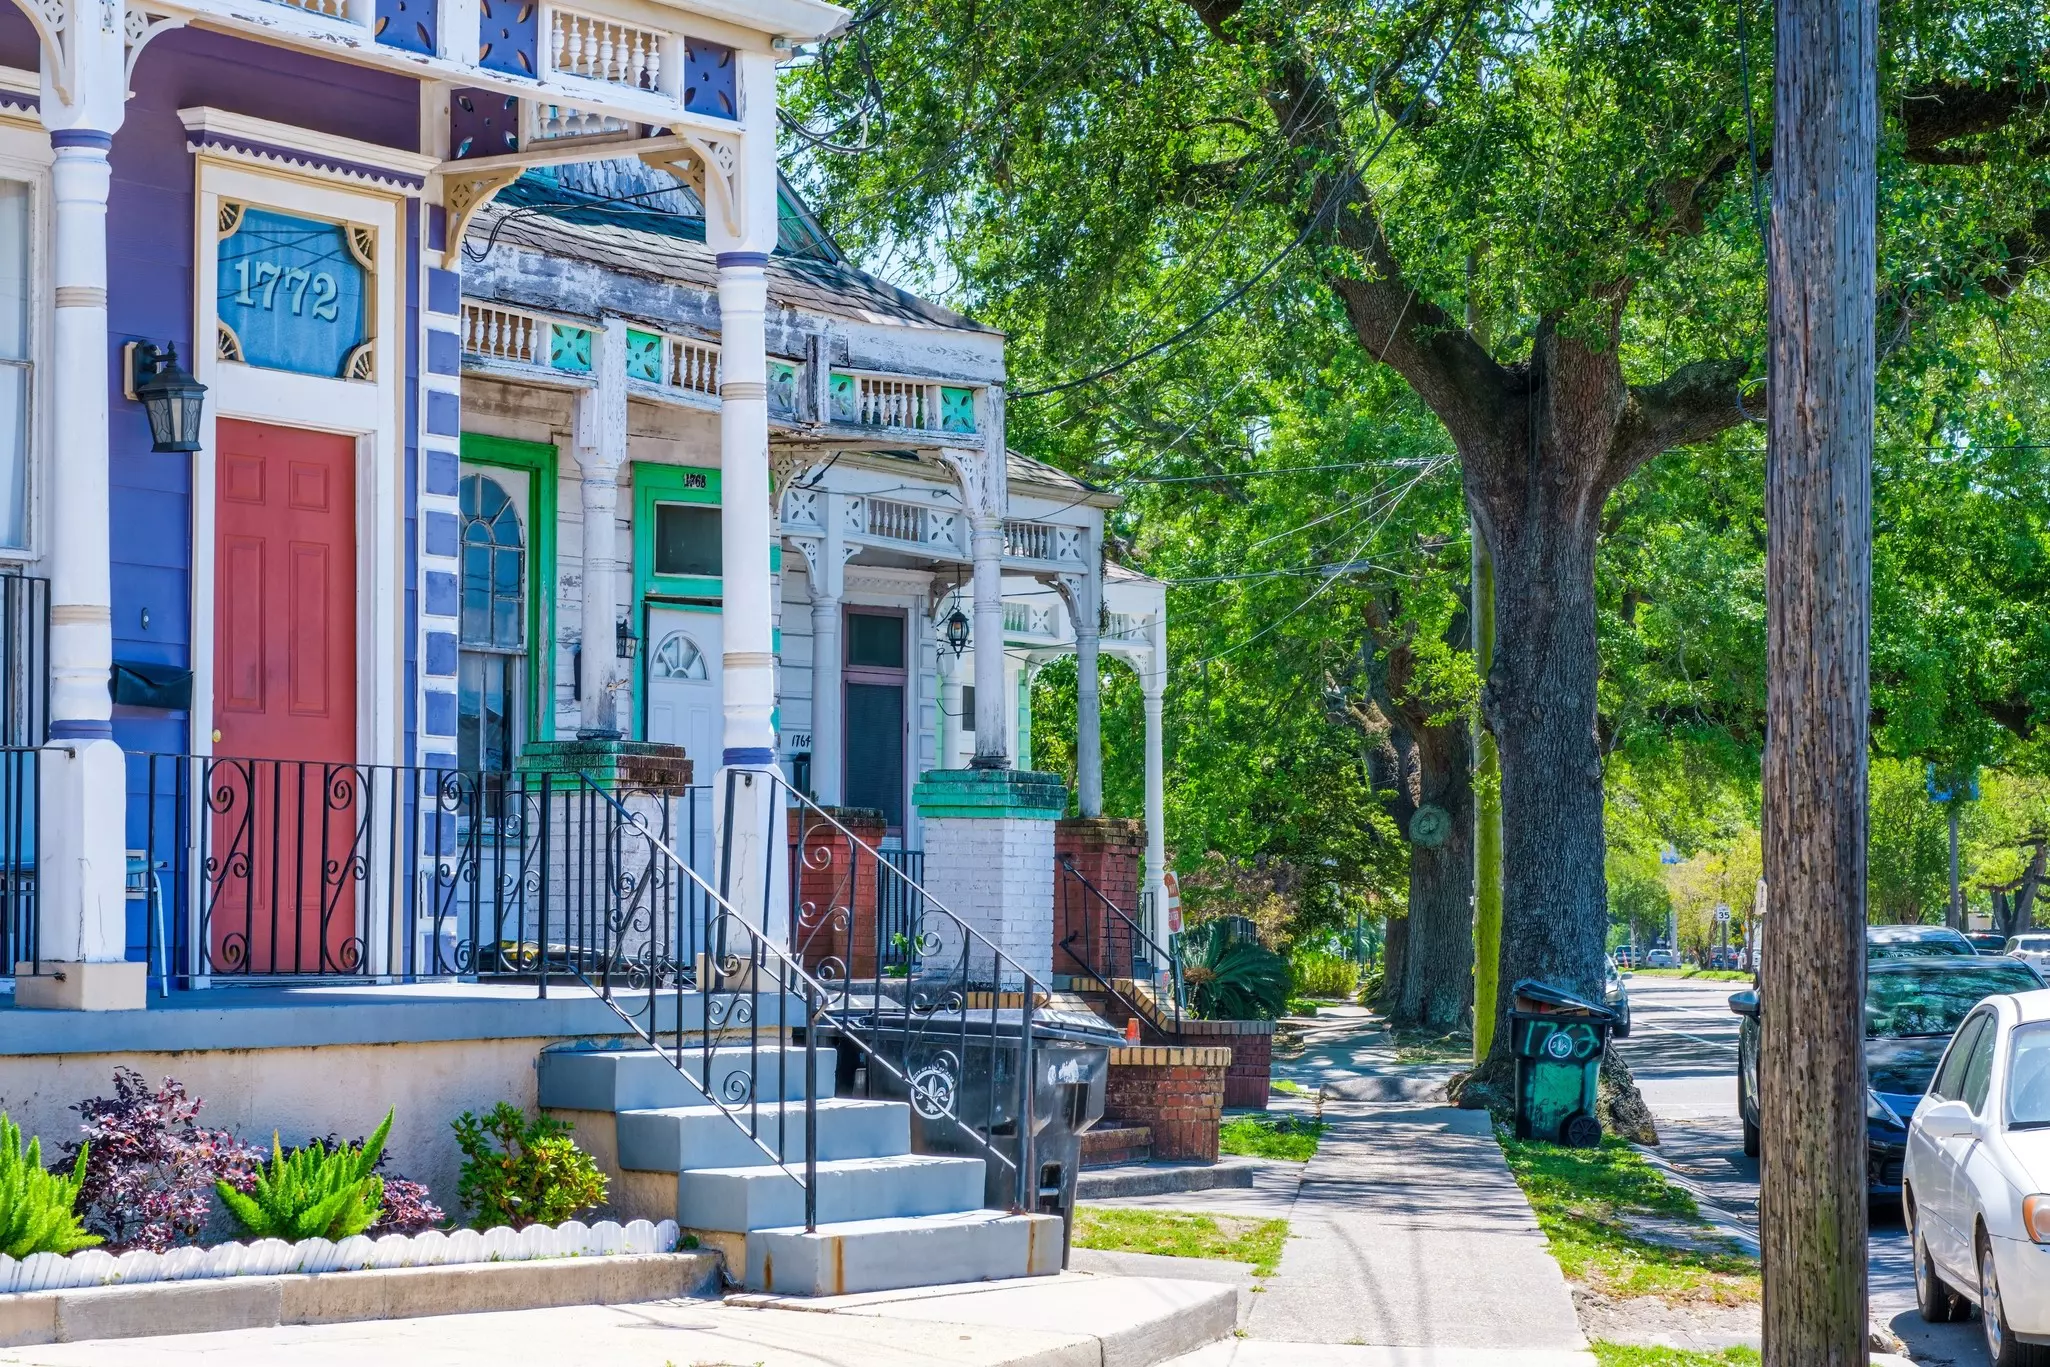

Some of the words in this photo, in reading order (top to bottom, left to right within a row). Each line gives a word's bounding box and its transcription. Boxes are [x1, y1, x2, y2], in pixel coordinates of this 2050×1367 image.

[235, 259, 338, 323] 1772
[684, 473, 706, 488] 1768
[791, 735, 811, 747] 1764
[1718, 911, 1730, 919] 35
